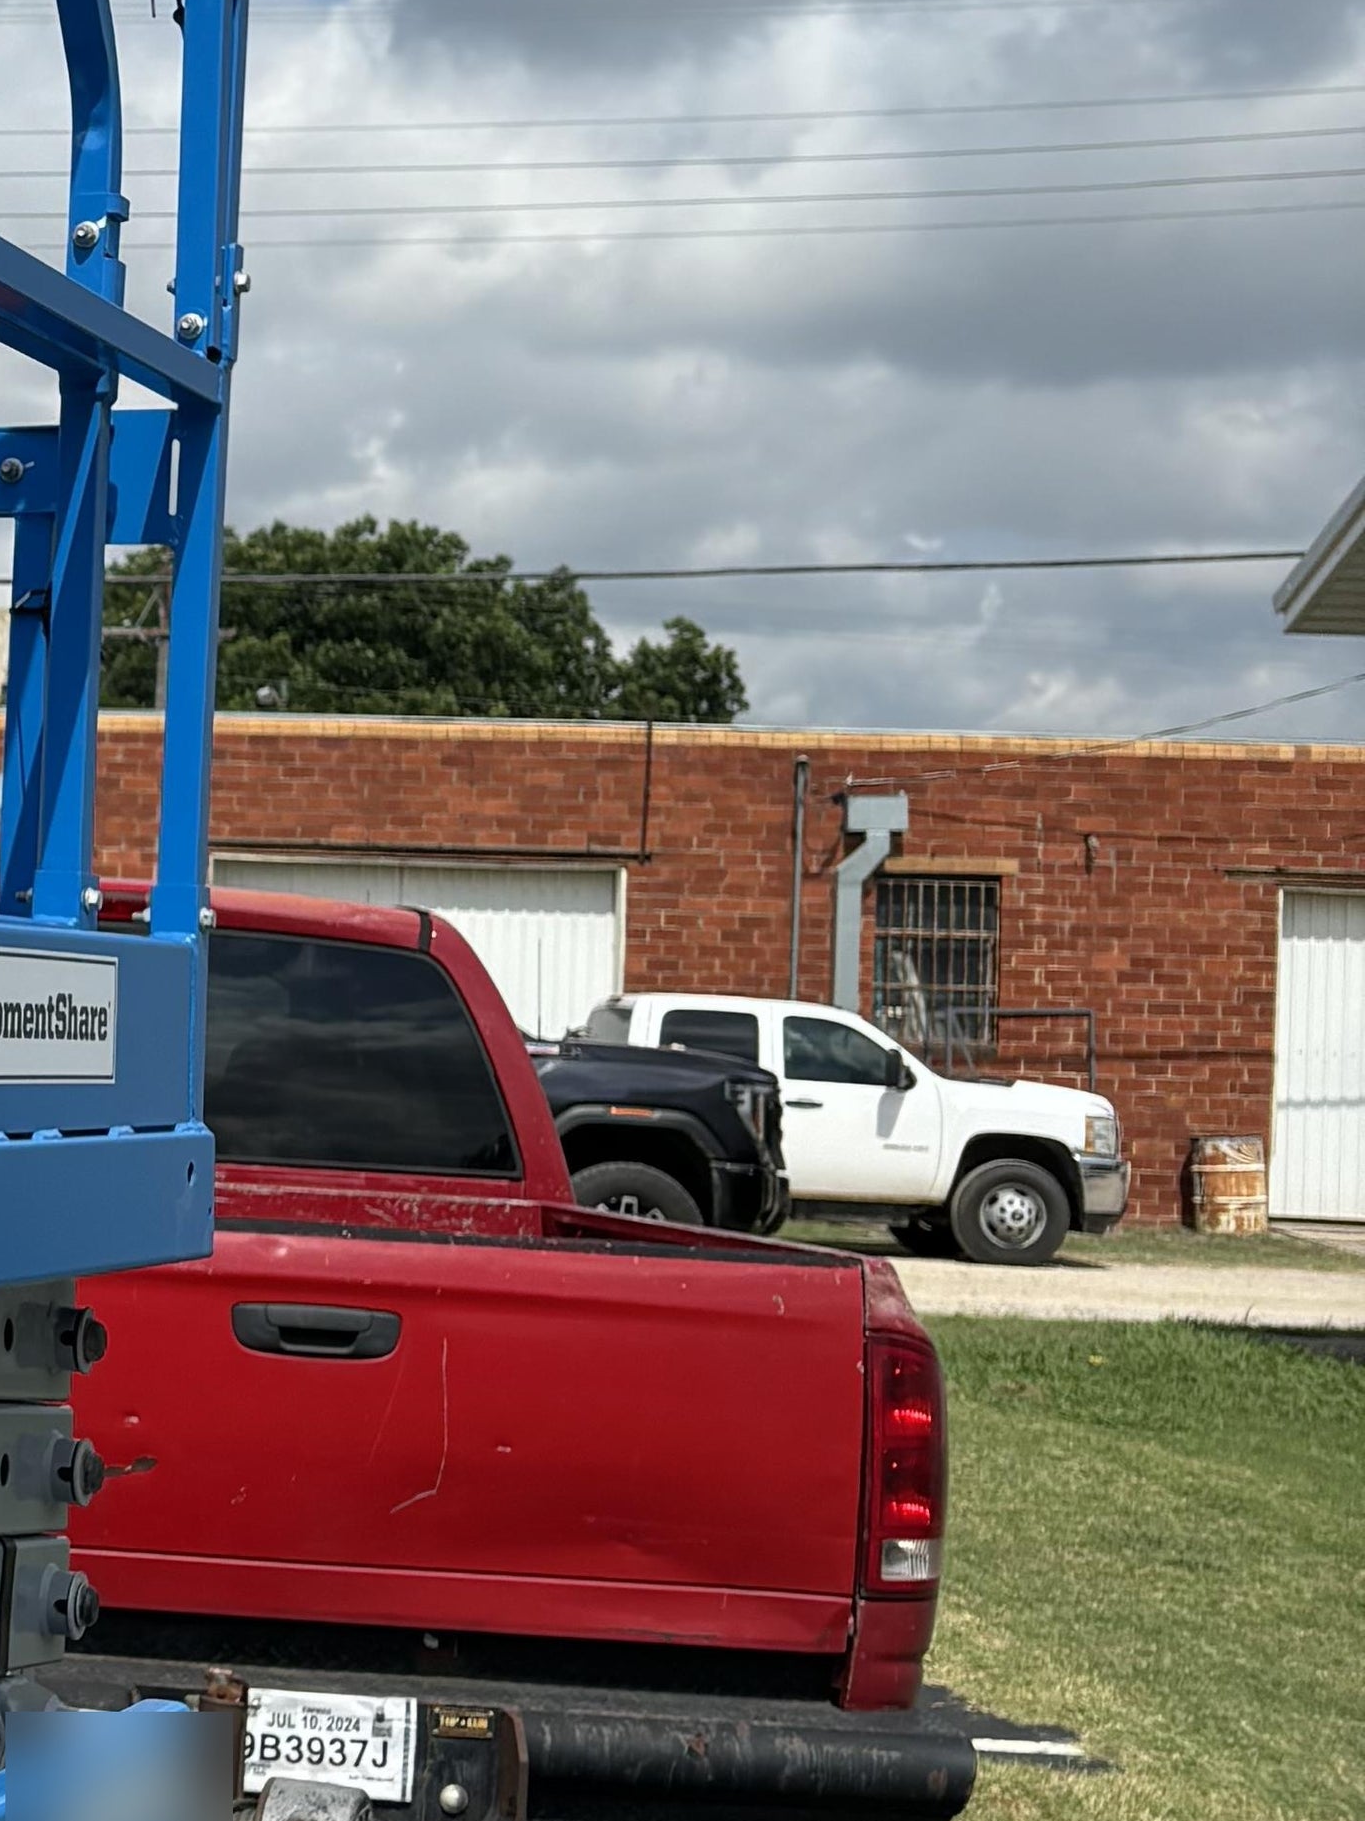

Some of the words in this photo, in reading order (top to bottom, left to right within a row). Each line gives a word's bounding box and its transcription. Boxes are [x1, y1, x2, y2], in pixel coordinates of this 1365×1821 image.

[267, 1712, 296, 1729] JUL
[302, 1715, 322, 1732] 10,
[326, 1716, 360, 1732] 2024
